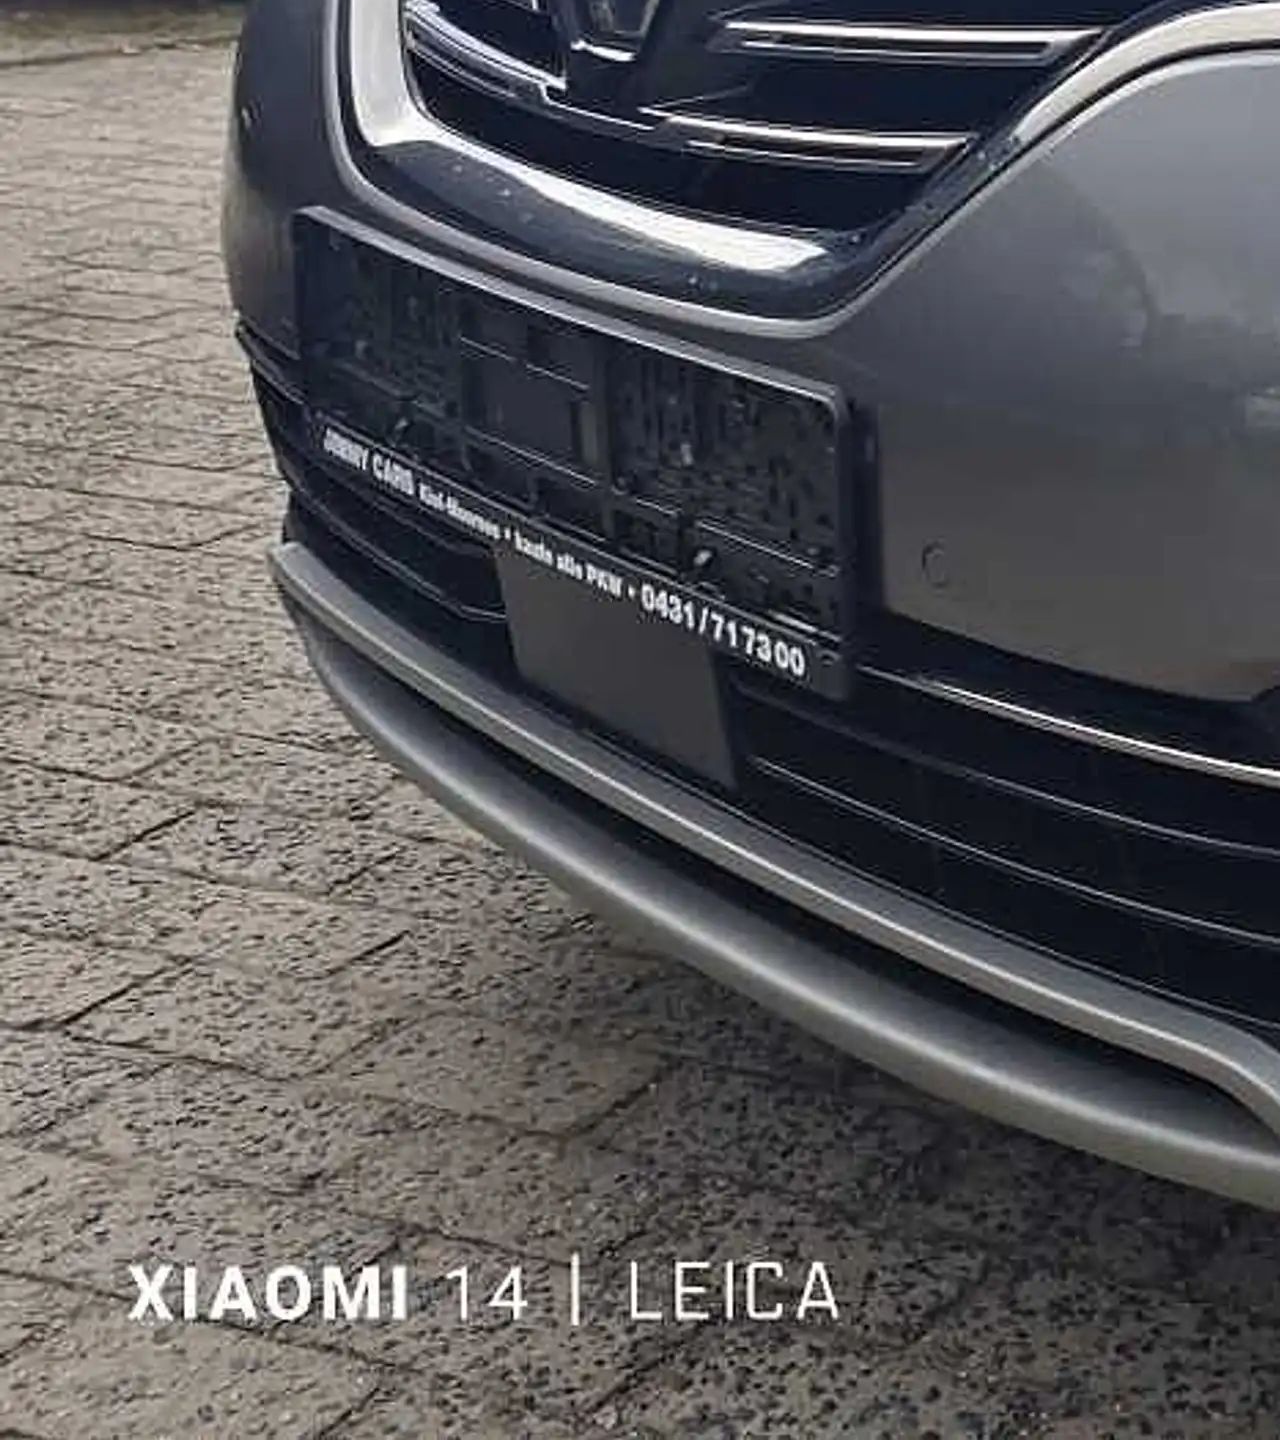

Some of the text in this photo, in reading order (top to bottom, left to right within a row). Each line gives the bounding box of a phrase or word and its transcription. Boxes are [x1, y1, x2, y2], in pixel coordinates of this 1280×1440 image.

[372, 452, 416, 497] CARS
[585, 558, 624, 599] PKW
[640, 581, 807, 677] 0431/717300
